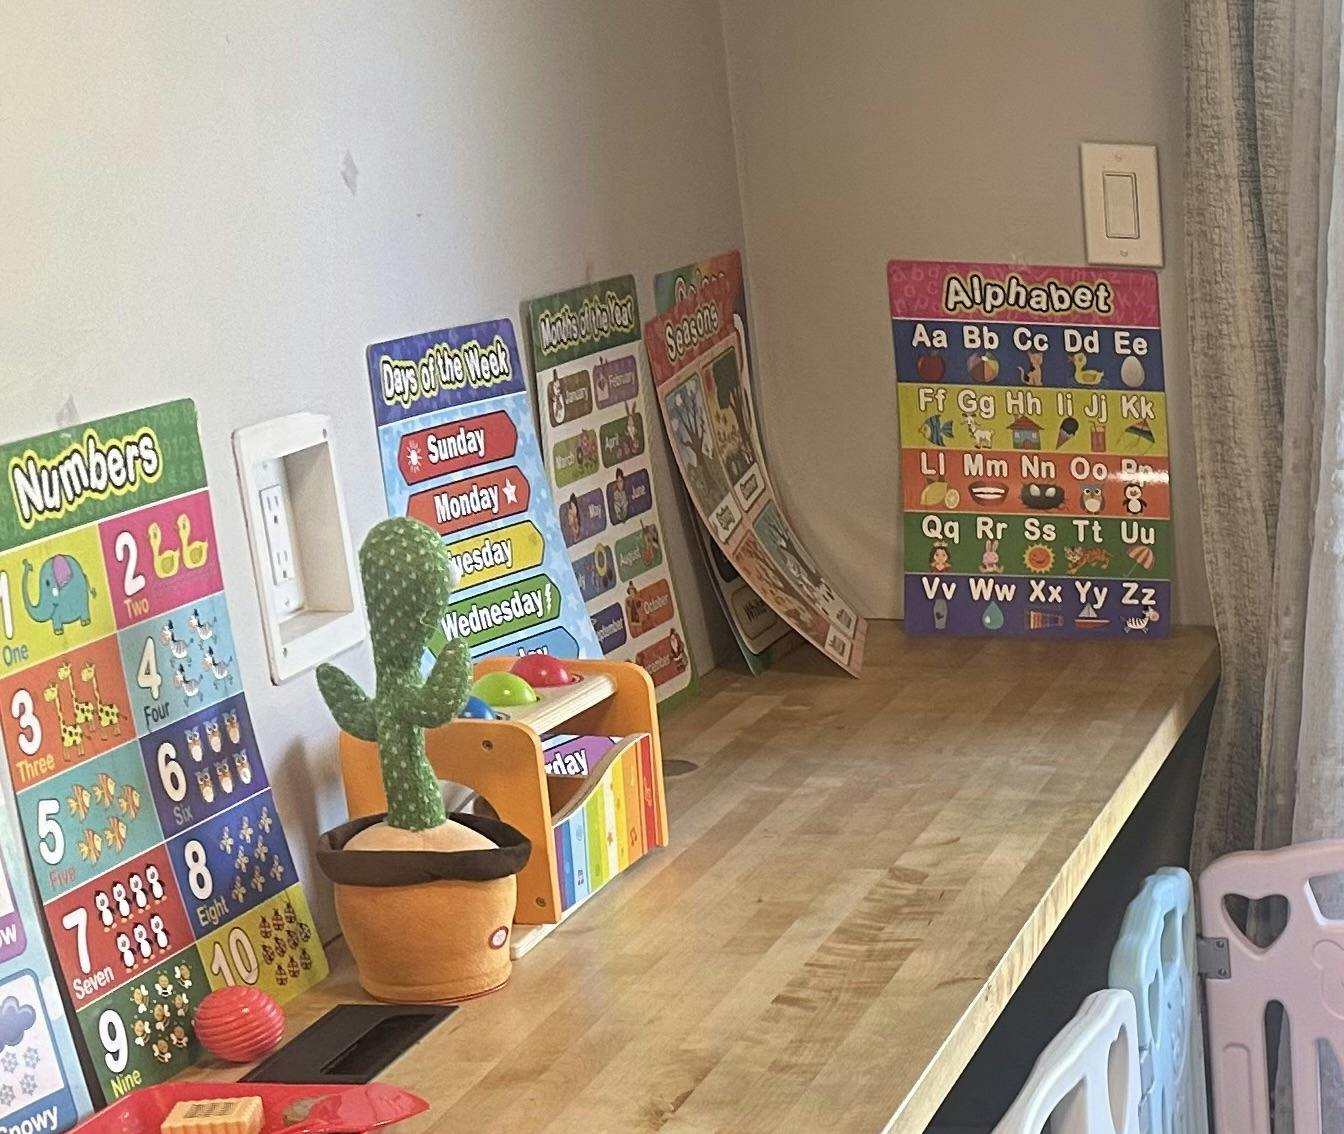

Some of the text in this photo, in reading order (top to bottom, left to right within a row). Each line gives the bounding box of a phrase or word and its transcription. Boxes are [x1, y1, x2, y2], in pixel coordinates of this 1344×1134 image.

[946, 274, 1111, 313] Alphabet
[540, 308, 578, 351] Months
[607, 295, 633, 329] Year
[664, 303, 719, 362] Seasons
[911, 323, 1148, 355] Aa Bb Cc Dd Ee
[381, 339, 510, 404] Days of the Week
[918, 387, 948, 412] Ff
[957, 389, 995, 419] Gg
[1006, 391, 1042, 415] Hh
[1083, 394, 1107, 423] Jj
[1120, 395, 1155, 419] Kk
[426, 427, 485, 464] Sunday
[12, 433, 159, 523] Numbers
[963, 453, 1008, 477] Mm
[1021, 455, 1056, 479] Nn
[1070, 457, 1108, 480] Oo
[434, 483, 499, 524] Monday
[922, 515, 1156, 545] Qq Rr Ss Tt Uu
[115, 530, 147, 597] 2
[0, 570, 14, 640] 1
[124, 597, 149, 620] Two
[922, 577, 1156, 609] Vv Ww Xx Yy Zz
[441, 588, 544, 642] Wednesday
[3, 643, 28, 667] One
[137, 636, 163, 700] 4
[11, 689, 43, 756] 3
[144, 700, 170, 728] Four
[16, 753, 56, 783] Three
[157, 742, 188, 802] 6
[38, 798, 66, 866] 5
[173, 805, 194, 827] Six
[50, 869, 76, 889] Five
[184, 839, 214, 900] 8
[196, 899, 230, 928] Eight
[62, 907, 91, 975] 7
[211, 927, 259, 987] 10
[72, 965, 115, 1000] Seven
[98, 1009, 129, 1074] 9
[110, 1068, 143, 1098] Nine
